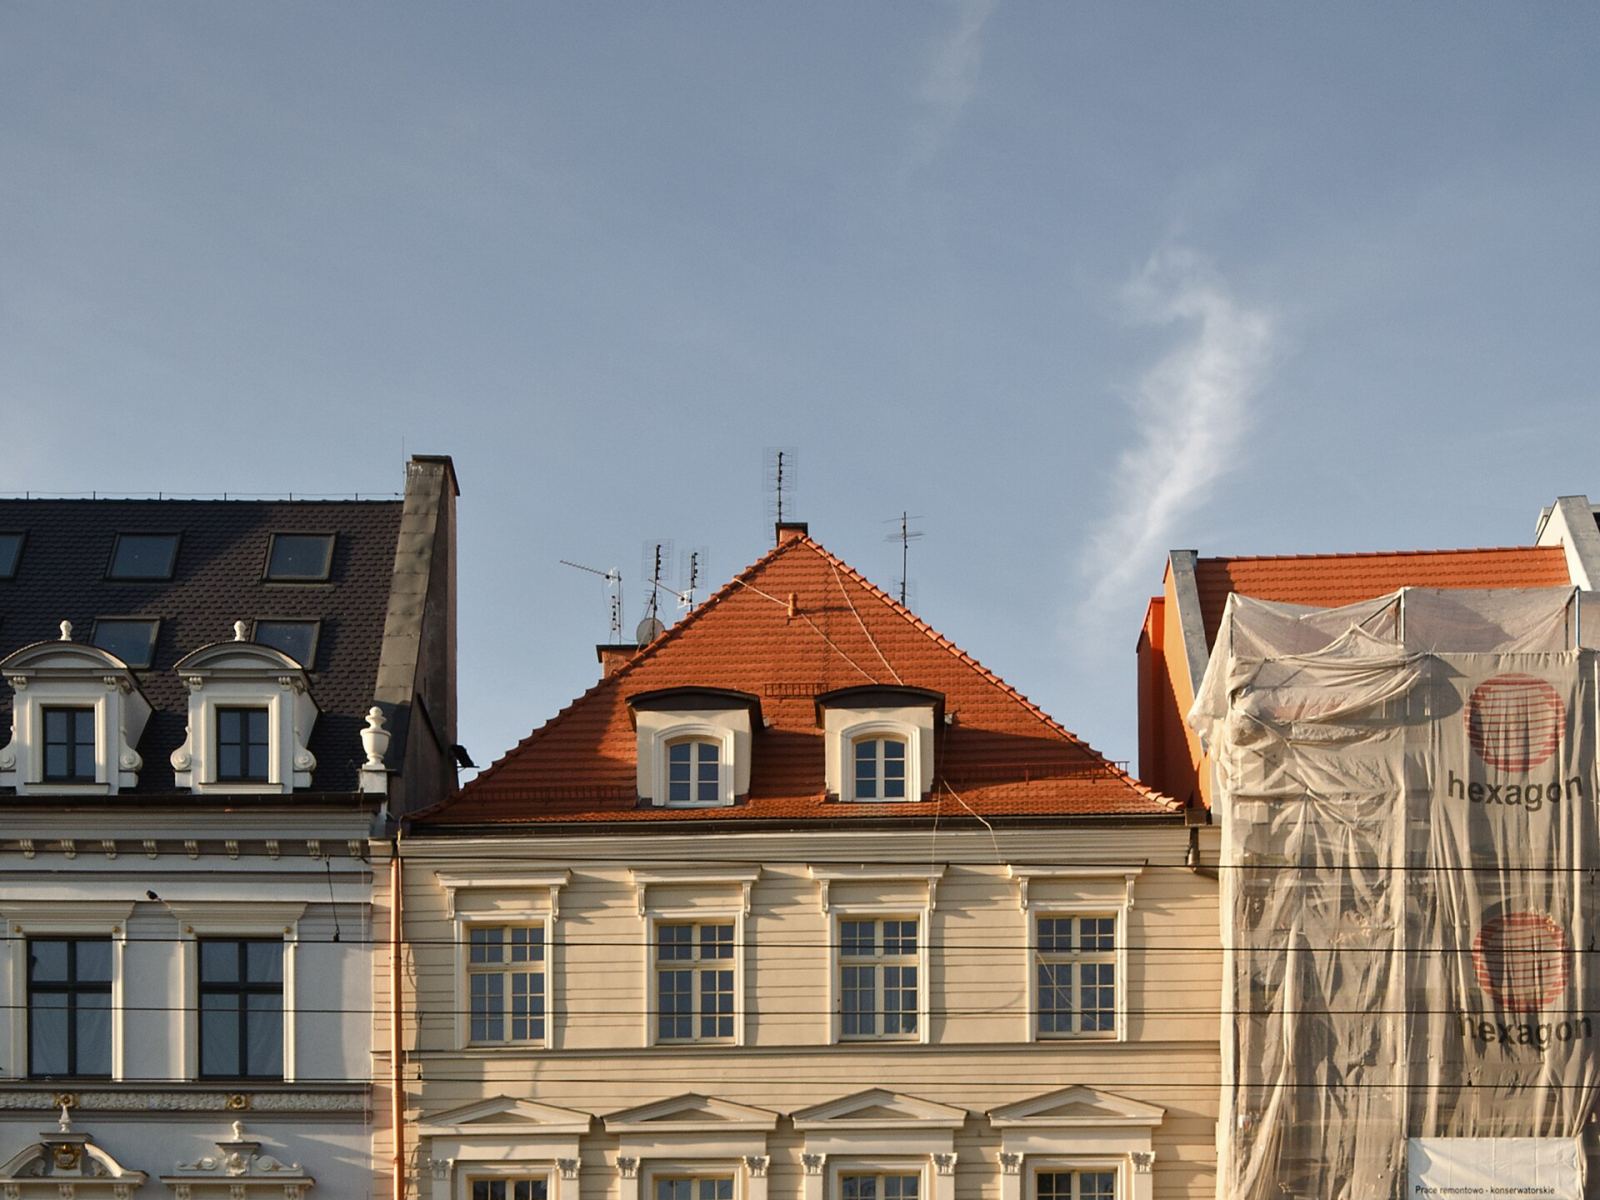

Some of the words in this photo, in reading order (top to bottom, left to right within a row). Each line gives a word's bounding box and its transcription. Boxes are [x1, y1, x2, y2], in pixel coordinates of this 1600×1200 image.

[1448, 770, 1583, 812] hexagon
[1459, 1008, 1592, 1053] hexagon
[1415, 1185, 1437, 1194] Prace
[1490, 1186, 1555, 1194] konserwatorskie
